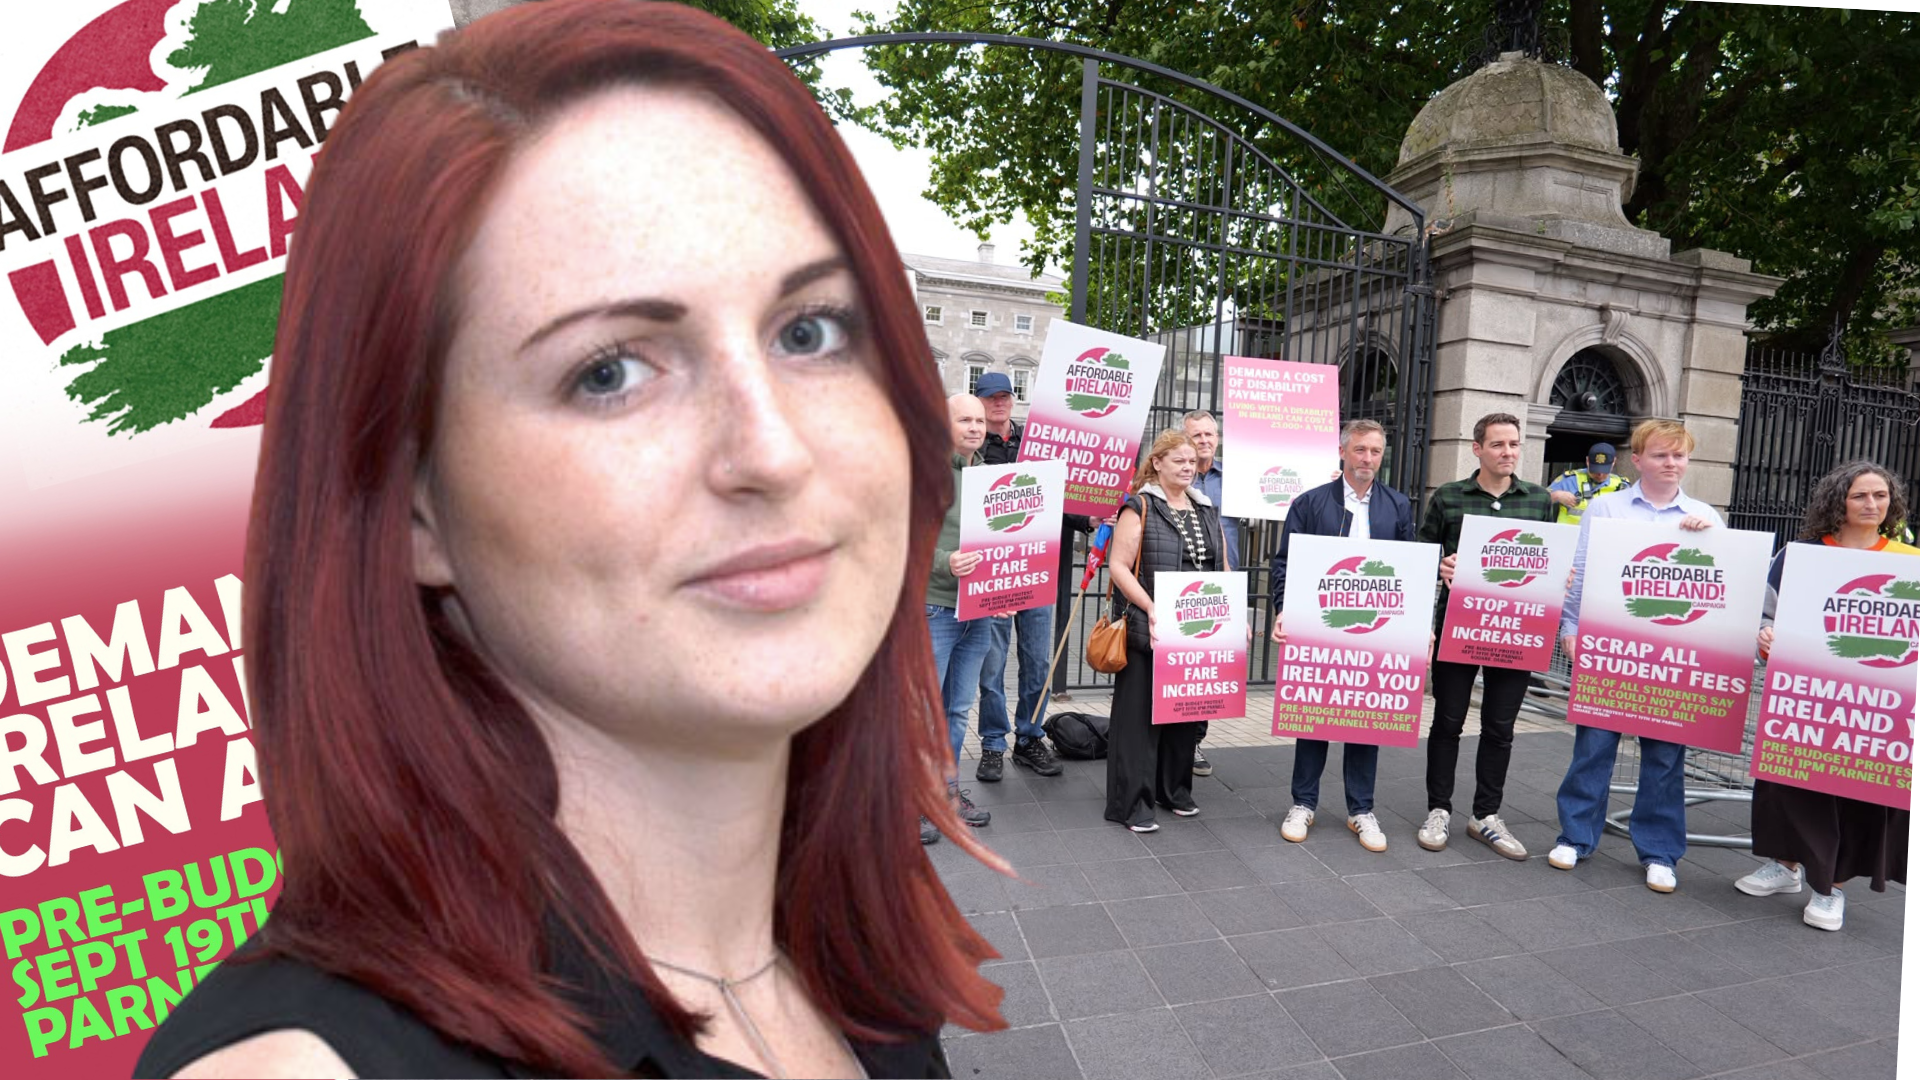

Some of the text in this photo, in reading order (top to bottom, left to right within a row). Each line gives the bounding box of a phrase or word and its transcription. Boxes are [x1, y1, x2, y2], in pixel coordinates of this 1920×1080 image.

[0, 39, 419, 251] AFFORDAB
[64, 152, 321, 320] IRELA
[1066, 364, 1133, 384] AFFORDABLE
[1228, 366, 1325, 384] DEMAND A COST
[1073, 377, 1133, 399] IRELAND!
[1228, 389, 1283, 403] PAYMENT
[1229, 377, 1311, 394] OF DISABILITY
[1229, 402, 1256, 411] LIVING
[1258, 404, 1280, 413] WITH
[1291, 407, 1334, 417] DISABILITY
[1239, 410, 1248, 418] IN
[1250, 411, 1283, 420] IRELAND
[1286, 415, 1302, 423] CAN
[1305, 416, 1325, 424] COST
[1028, 422, 1128, 453] DEMAND AN
[1314, 424, 1334, 433] YEAR
[1024, 441, 1132, 472] IRELAND YOU
[1066, 466, 1120, 487] FFORD
[1259, 477, 1302, 485] AFFORDABLE
[983, 485, 1042, 505] AFFORDABLE
[1069, 484, 1104, 495] PROTEST
[1105, 489, 1124, 498] SEPT
[992, 495, 1044, 516] IRELAND!
[976, 541, 1047, 563] STOP THE
[1481, 545, 1548, 557] AFFORDABLE
[992, 559, 1028, 576] FARE
[1489, 555, 1549, 569] IRELAND!
[968, 571, 1049, 596] INCREASES
[1621, 565, 1723, 583] AFFORDABLE
[1317, 578, 1402, 592] AFFORDABLE
[1634, 579, 1725, 601] IRELAND!
[1175, 595, 1228, 609] AFFORDABLE
[1329, 591, 1404, 609] IRELAND!
[1463, 596, 1546, 617] STOP THE
[1692, 601, 1726, 609] CAMPAIGN
[1183, 604, 1230, 620] IRELAND!
[1480, 613, 1522, 630] FARE
[1452, 626, 1545, 648] INCREASES
[1167, 650, 1235, 666] STOP THE
[1284, 644, 1410, 671] DEMAND AN
[1581, 634, 1700, 667] SCRAP ALL
[1184, 666, 1218, 681] FARE
[1282, 664, 1420, 692] IRELAND YOU
[1579, 653, 1746, 694] STUDENT FEES
[1162, 680, 1239, 699] INCREASES
[1280, 684, 1409, 711] CAN AFFORD
[1577, 674, 1735, 708] 57% OF ALL STUDENTS SAY
[1771, 671, 1902, 710] DEMAND
[1574, 694, 1696, 723] AN UNEXPECTED BILL
[1576, 683, 1727, 718] THEY COULD NOT AFFORD
[1279, 703, 1418, 723] PRE-BUDGET PROTEST SEPT
[1279, 712, 1303, 723] 19TH
[1306, 714, 1325, 725] 1PM
[1327, 717, 1369, 729] PARNELL
[1603, 708, 1624, 716] PROTEST
[1767, 694, 1894, 734] IRELAND
[1278, 722, 1314, 733] DUBLIN
[1764, 719, 1825, 747] CAN
[1762, 740, 1851, 766] PRE-BUDGET
[1758, 762, 1810, 782] DUBLIN
[1761, 751, 1794, 766] 19TH
[1798, 759, 1825, 773] 1PM
[1828, 765, 1891, 786] PARNELL
[0, 758, 191, 877] CAN
[0, 847, 283, 959] PRE-BUD
[12, 897, 270, 1008] SEPT 19T
[22, 960, 225, 1058] PARN
